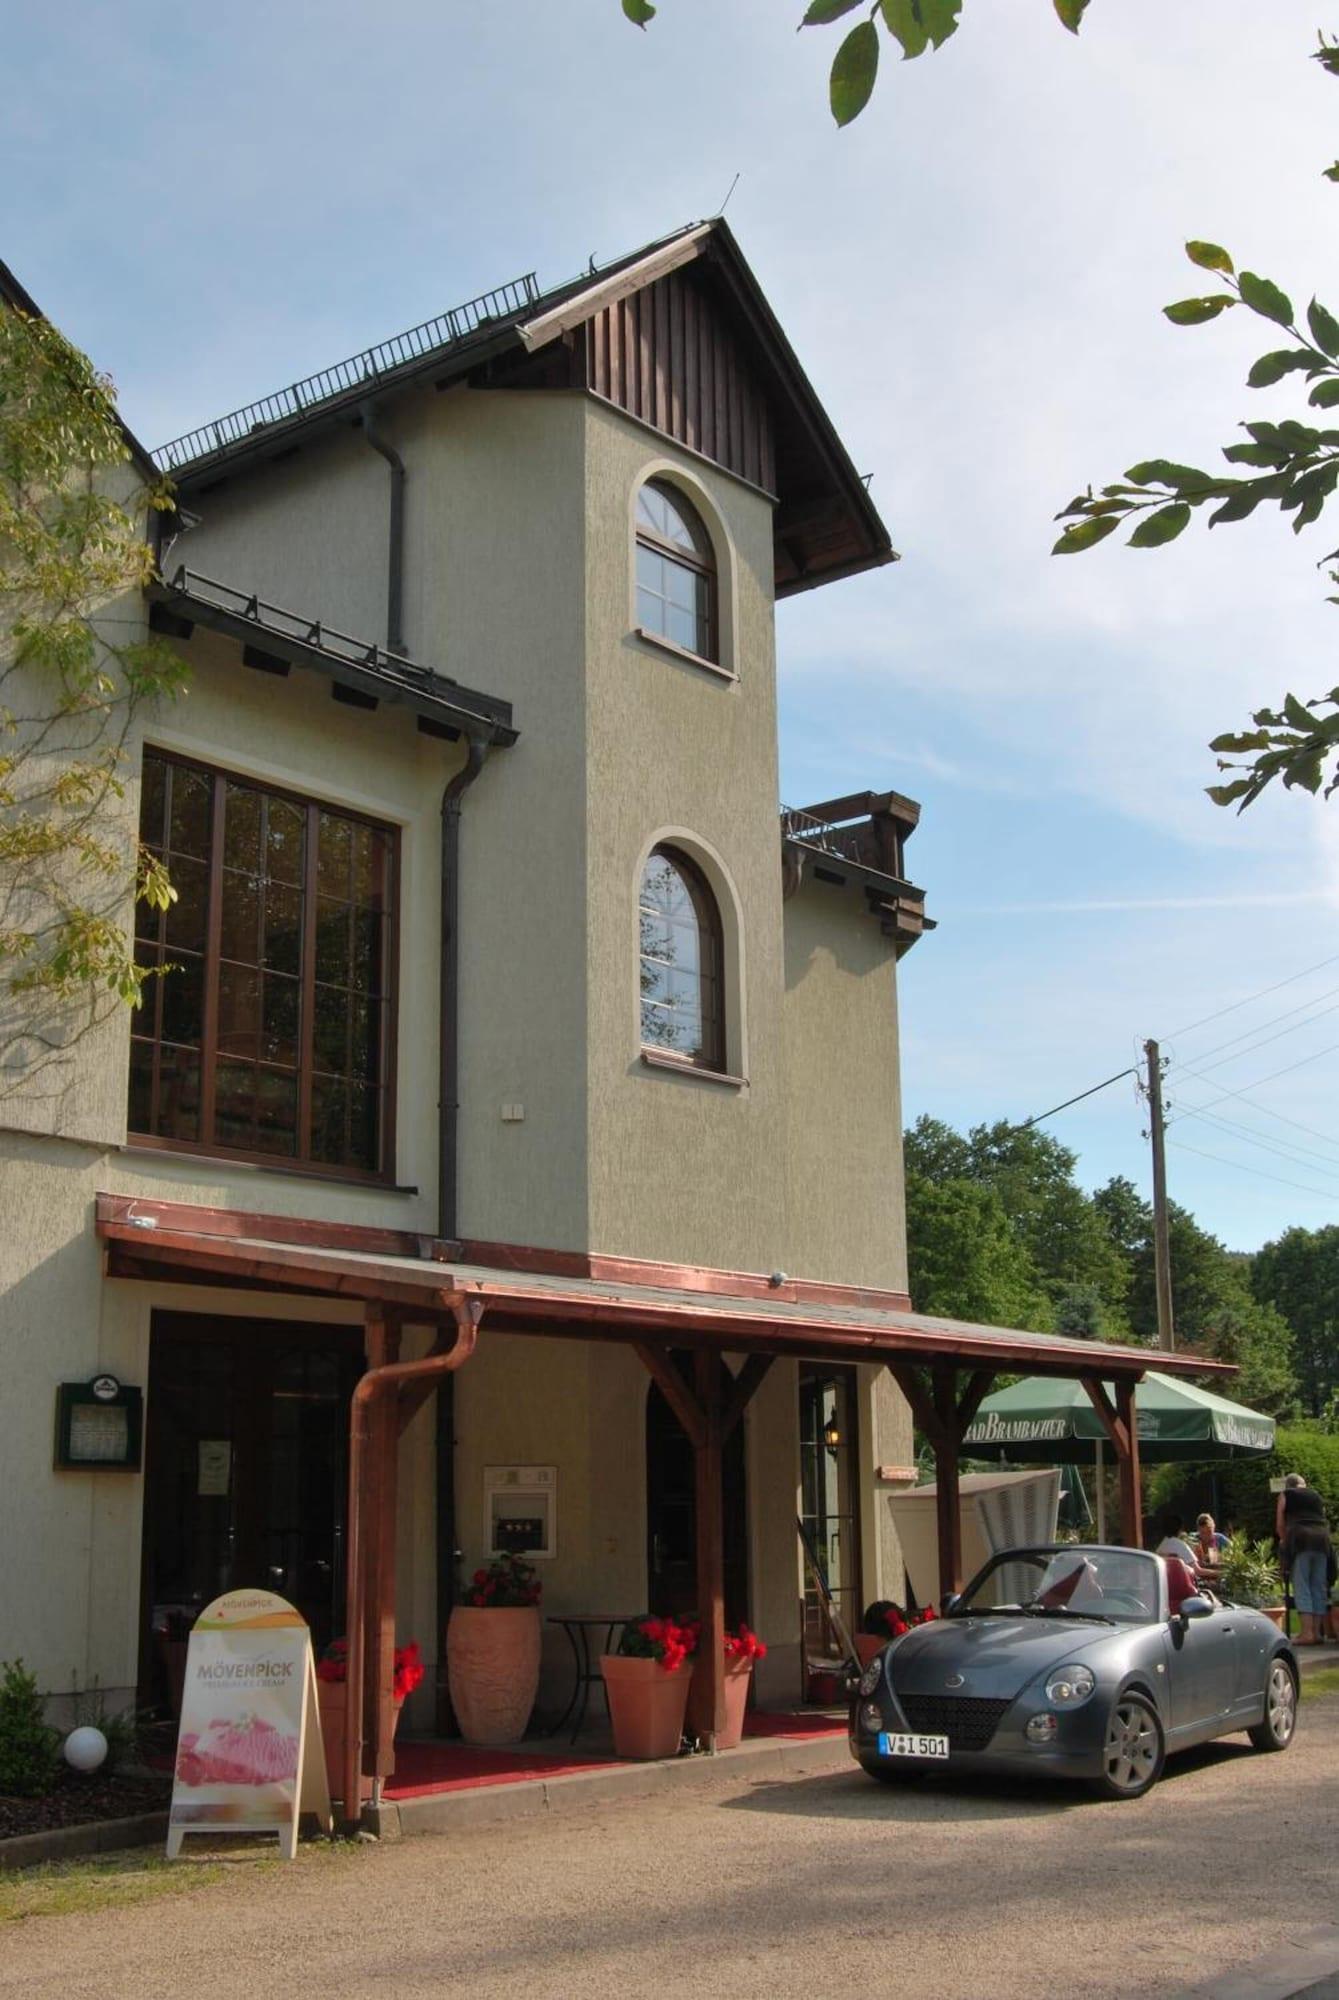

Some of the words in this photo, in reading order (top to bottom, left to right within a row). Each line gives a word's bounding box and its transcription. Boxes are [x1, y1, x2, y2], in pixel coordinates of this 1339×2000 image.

[197, 1659, 296, 1679] MÖVENPICK
[887, 1735, 896, 1753] V
[919, 1738, 947, 1756] 501
